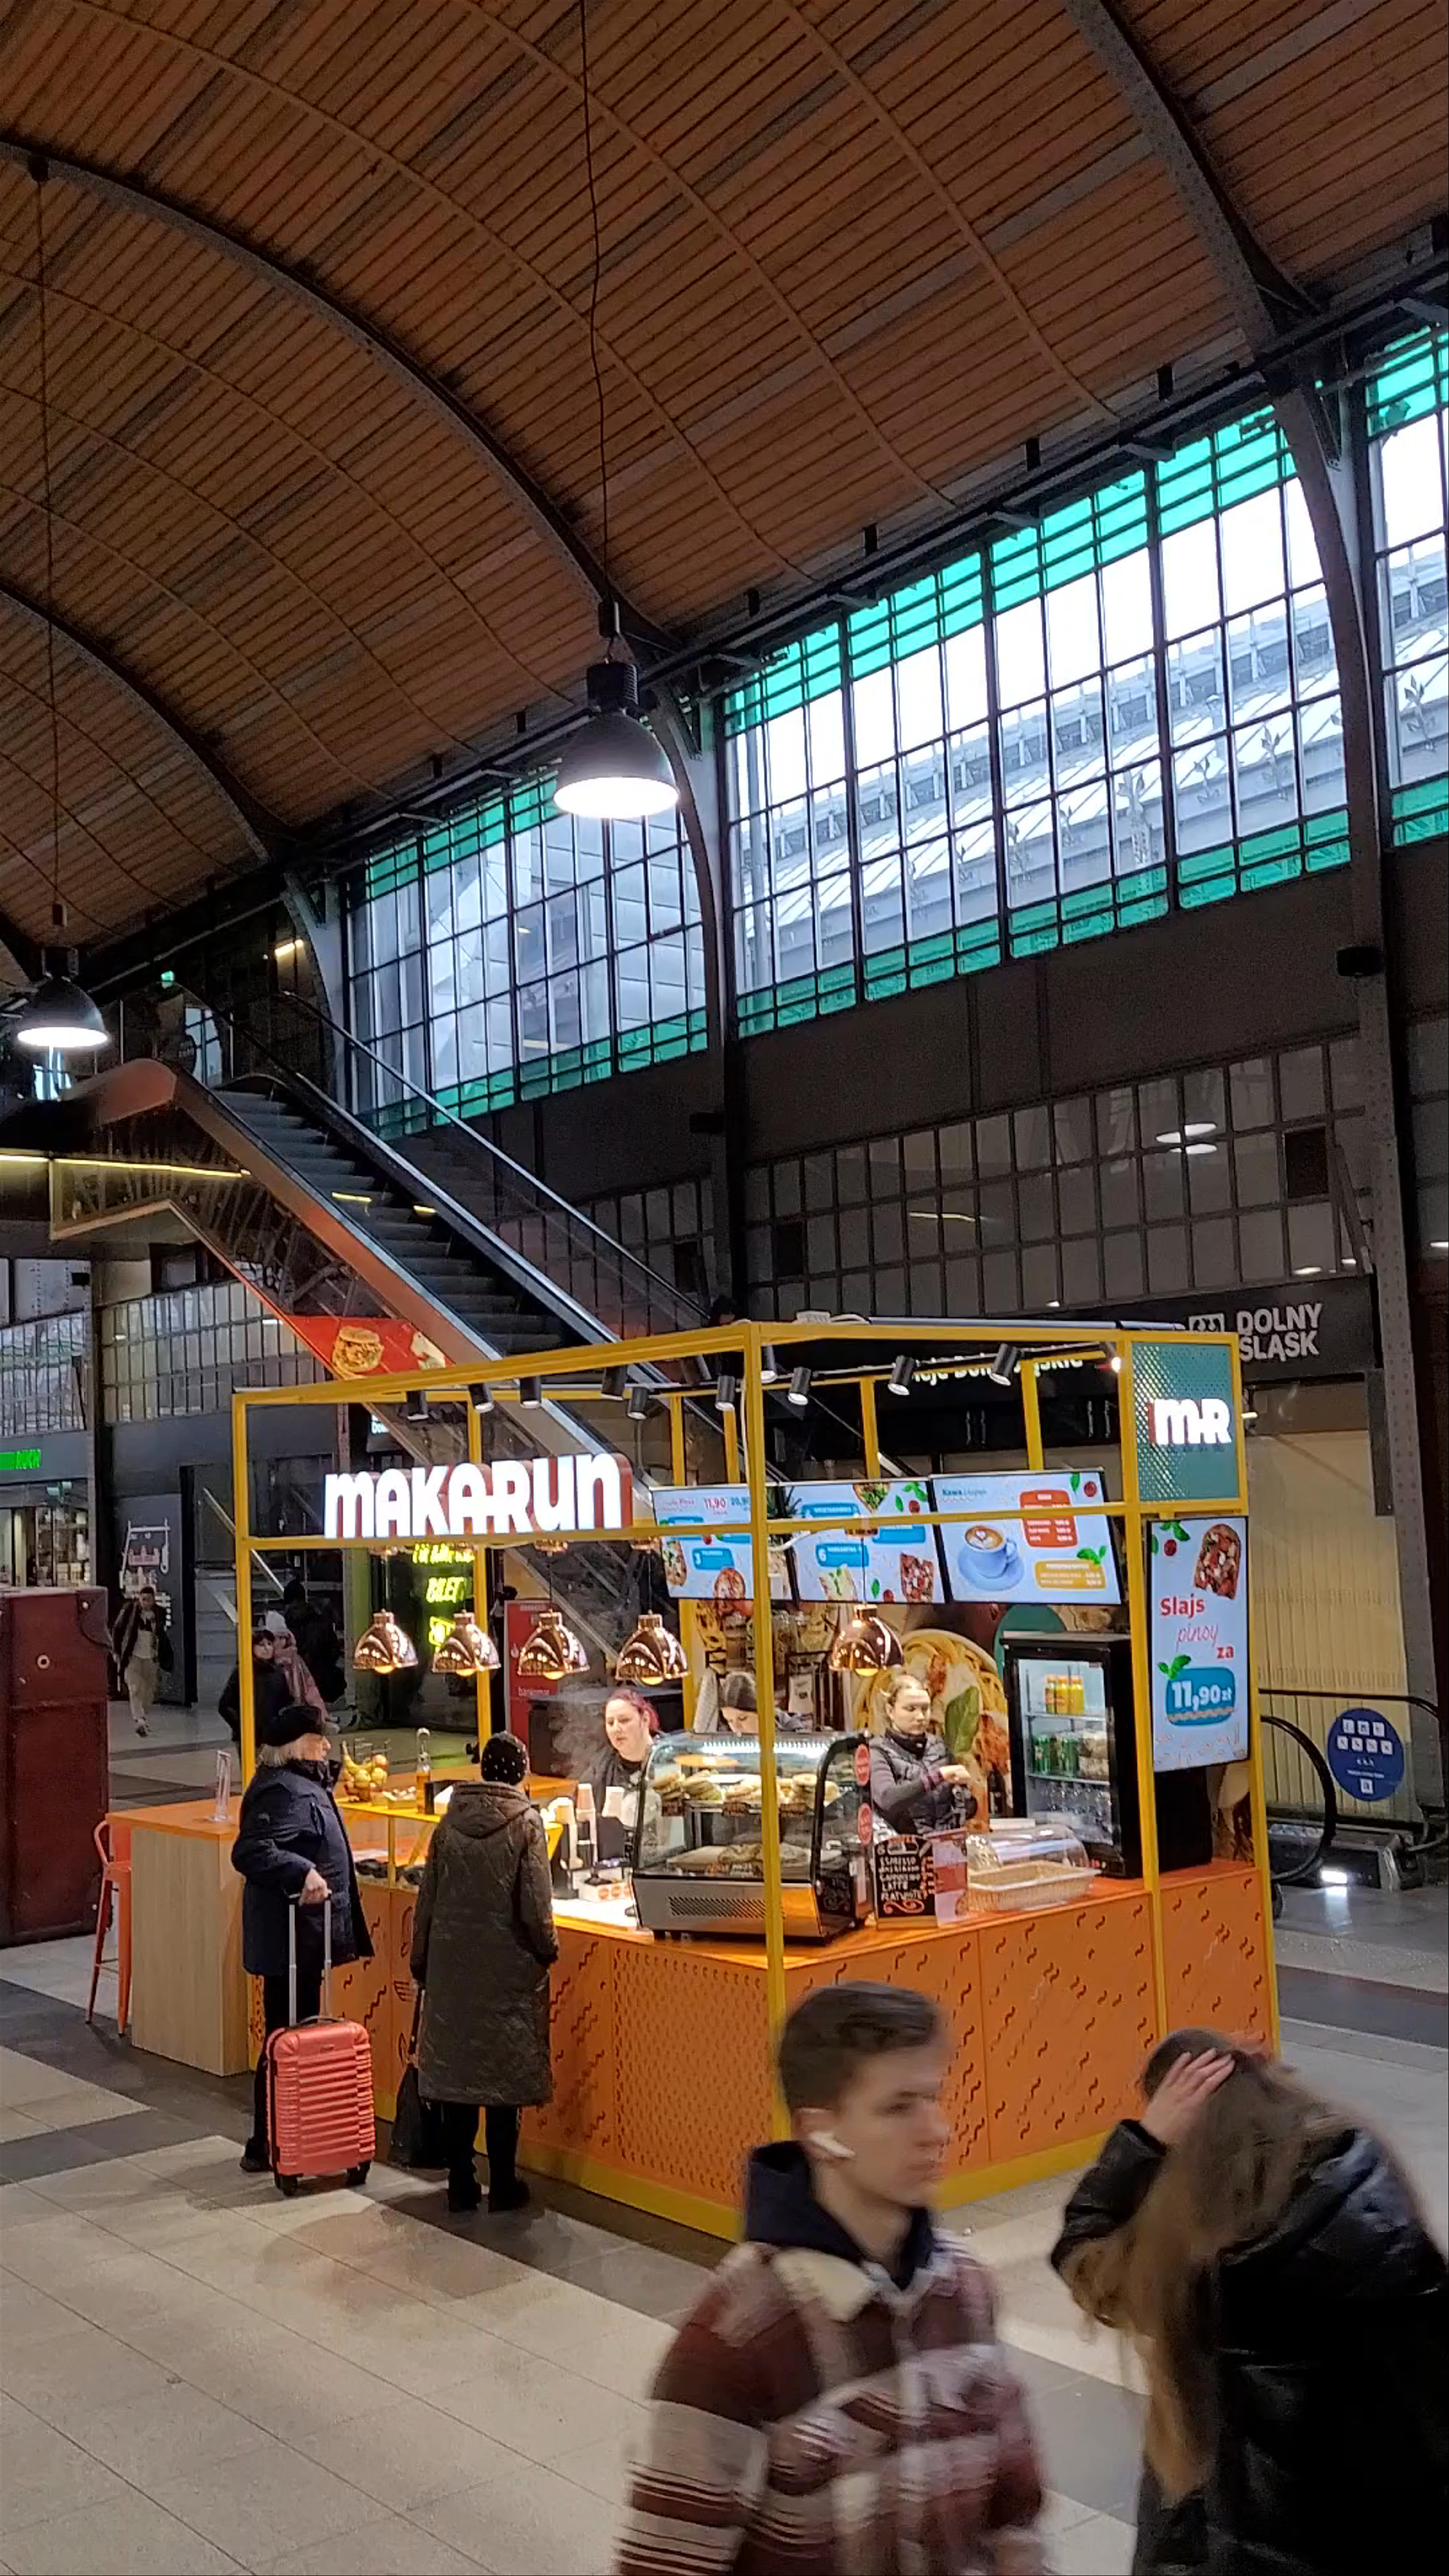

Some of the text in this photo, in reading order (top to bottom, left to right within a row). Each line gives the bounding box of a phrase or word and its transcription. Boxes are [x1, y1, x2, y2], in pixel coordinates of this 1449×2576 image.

[1237, 1303, 1321, 1336] DOLNY
[325, 1453, 625, 1539] MAKARUN
[1160, 1593, 1205, 1618] Slajs
[1217, 1646, 1234, 1659] za
